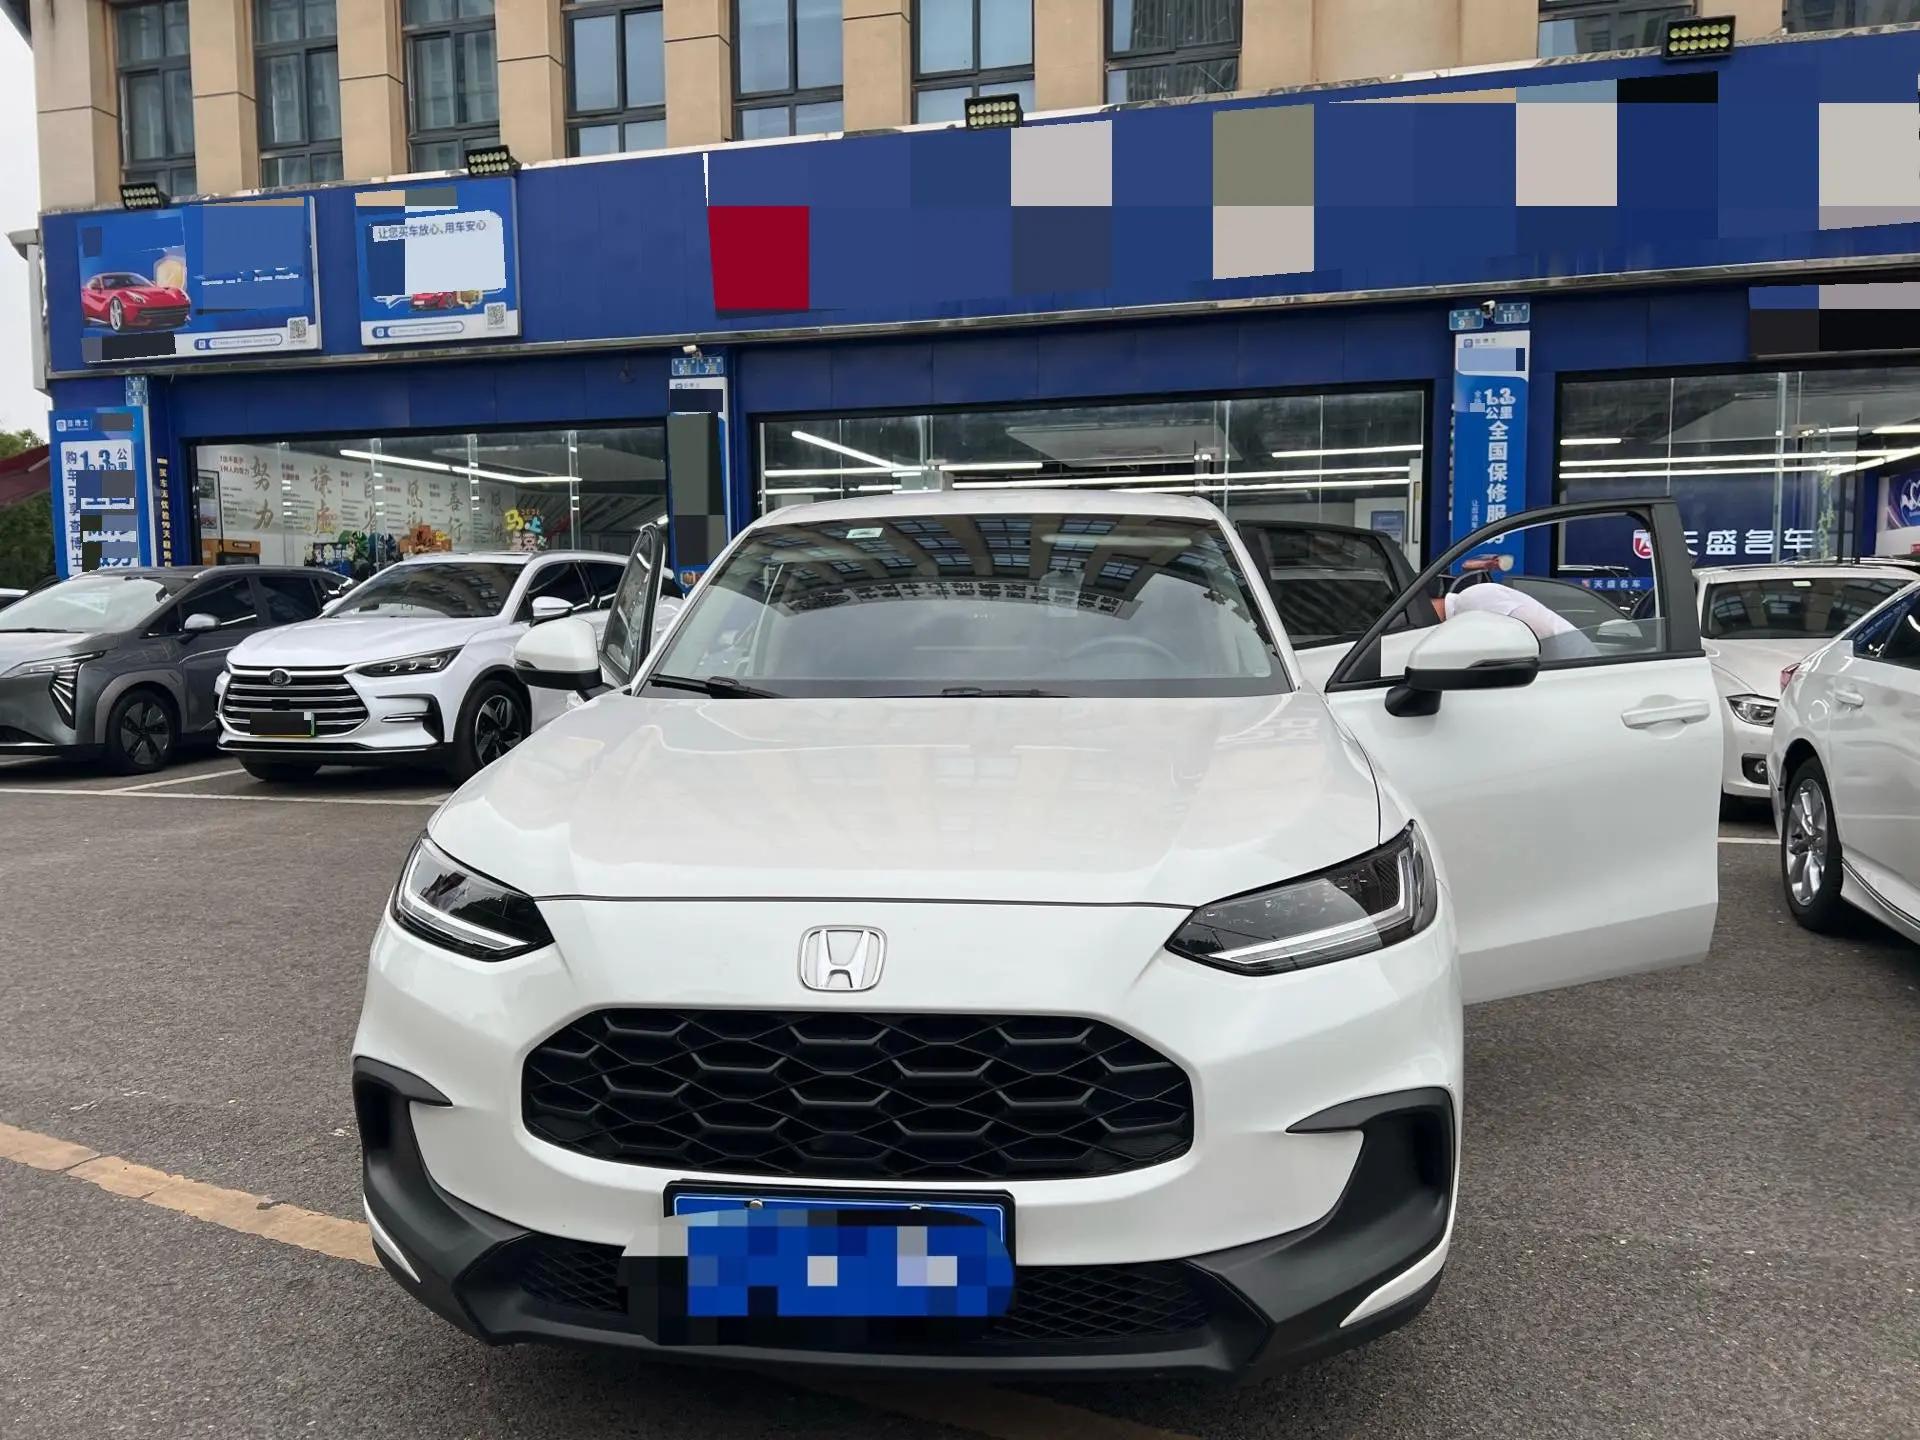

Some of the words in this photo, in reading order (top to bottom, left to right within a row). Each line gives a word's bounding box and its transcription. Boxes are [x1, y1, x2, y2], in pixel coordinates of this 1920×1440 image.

[378, 220, 487, 239] 让您买车放心、用车安心
